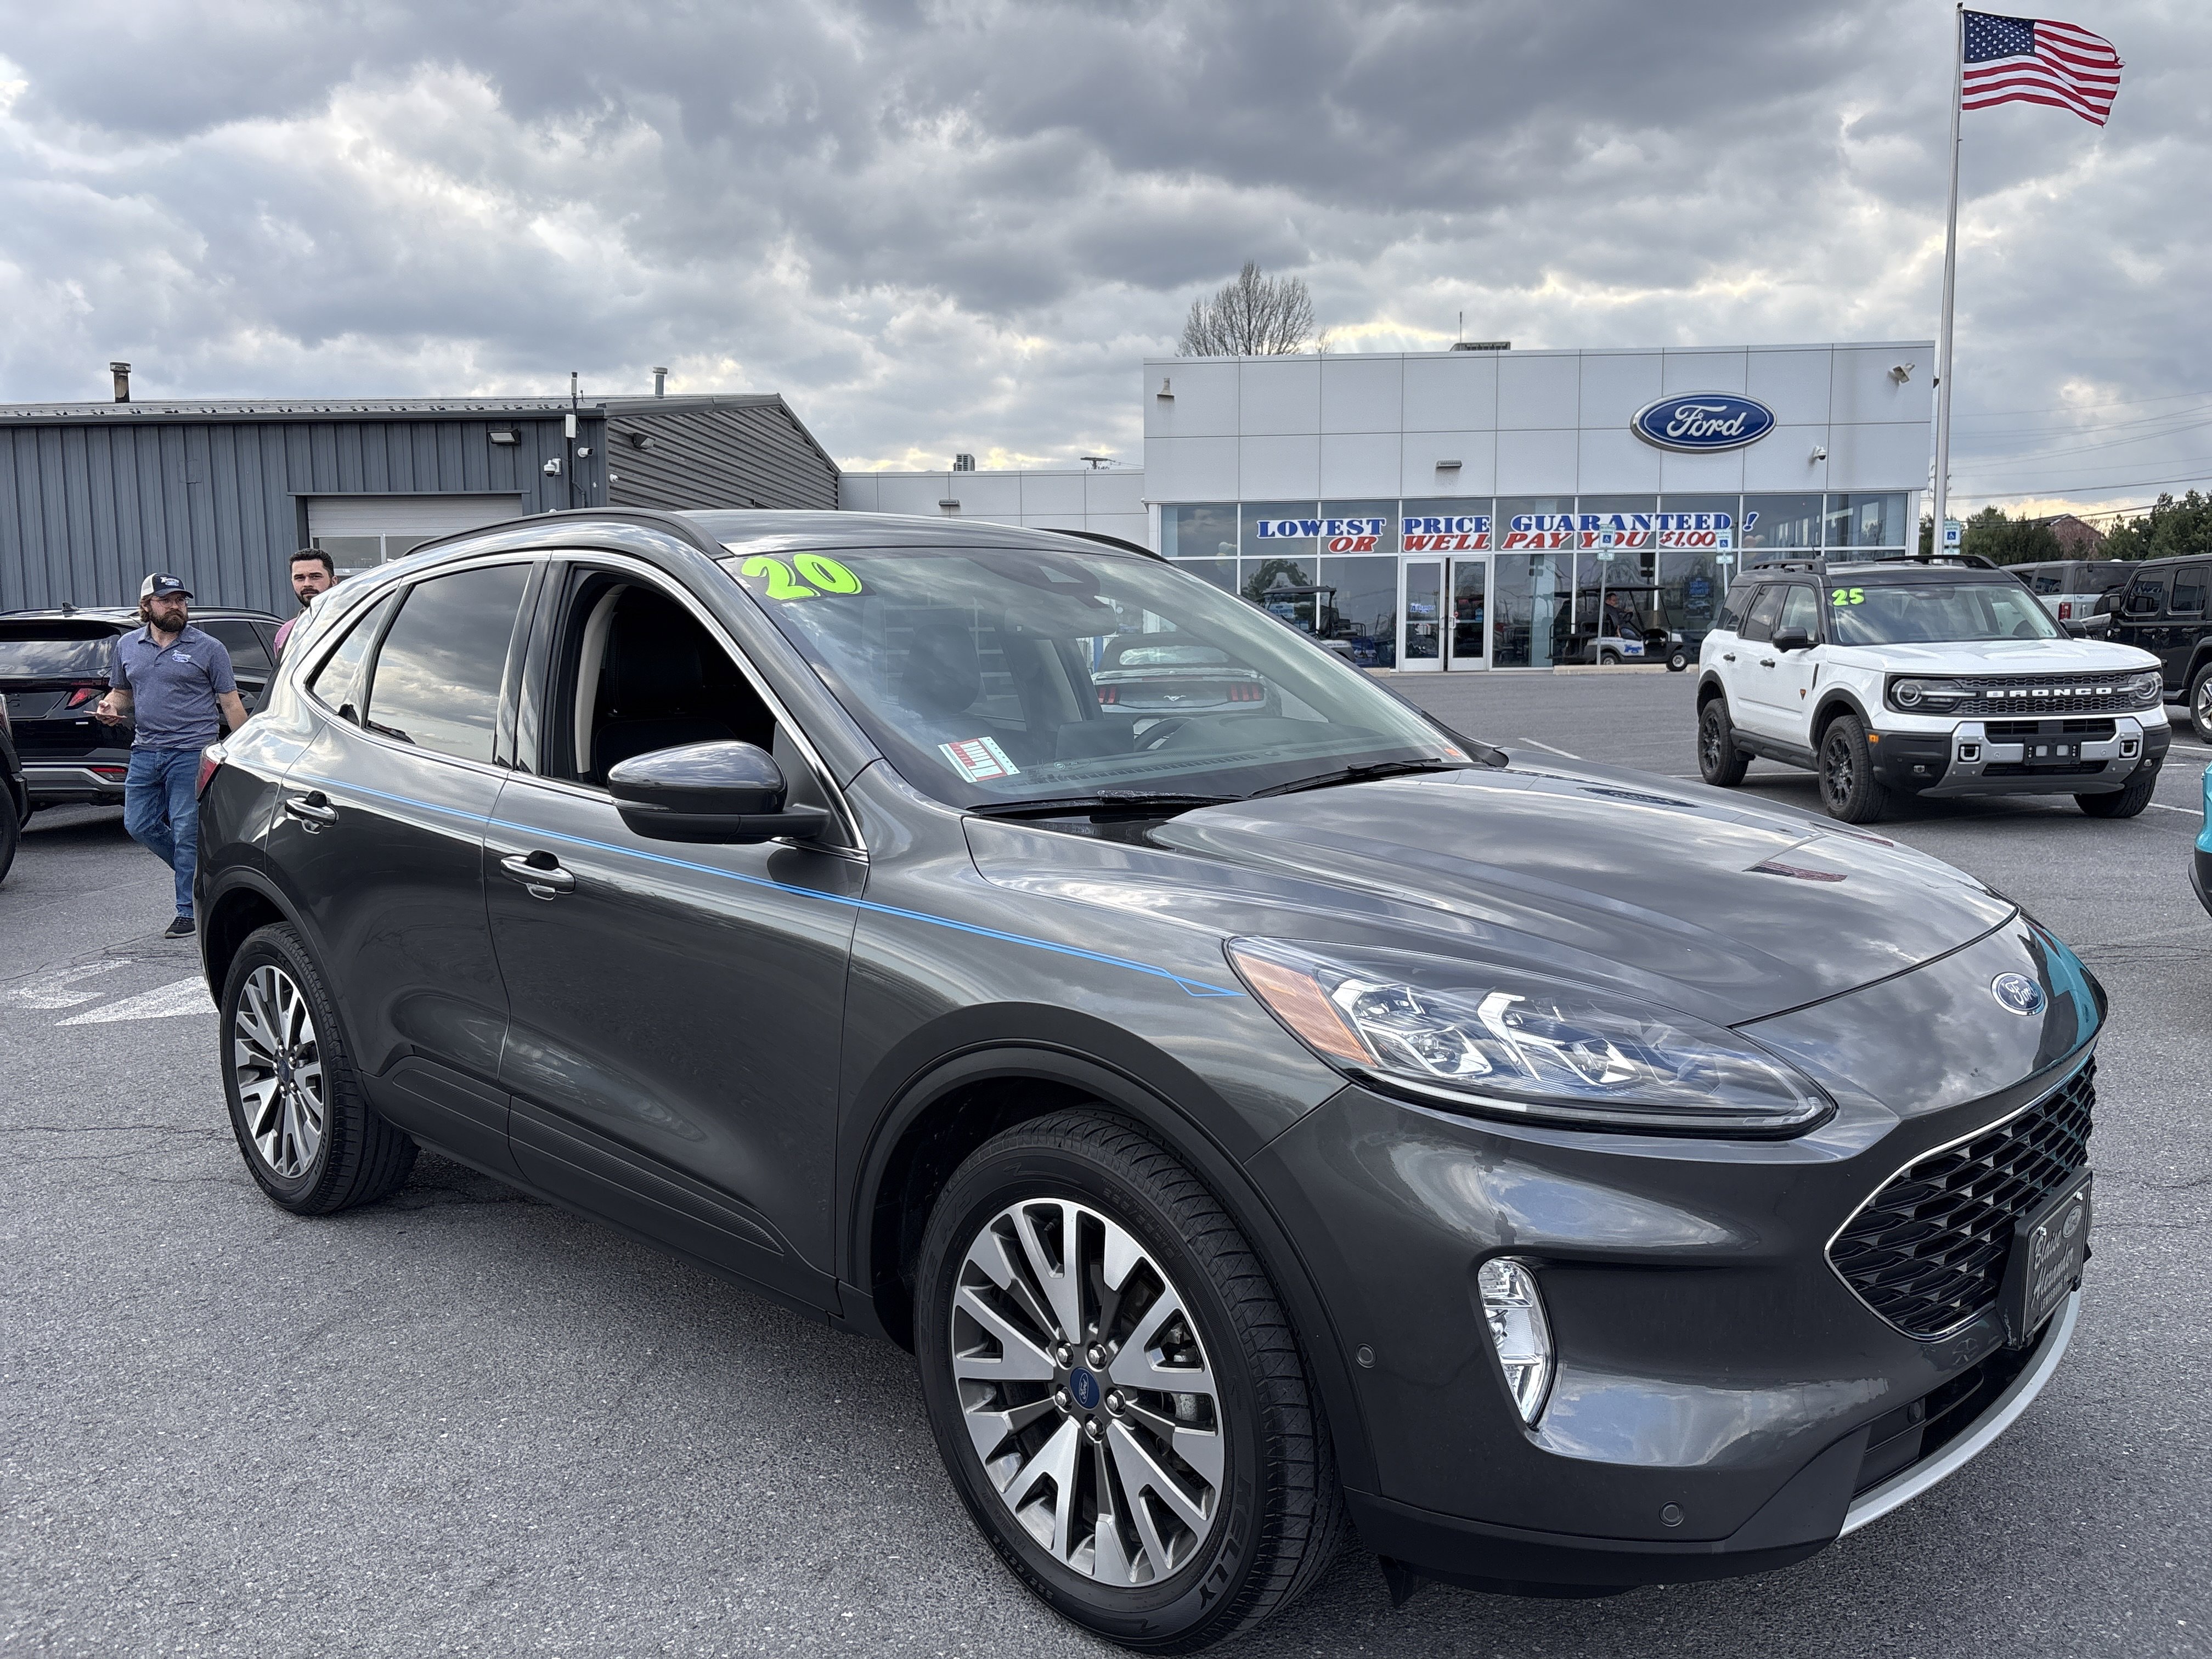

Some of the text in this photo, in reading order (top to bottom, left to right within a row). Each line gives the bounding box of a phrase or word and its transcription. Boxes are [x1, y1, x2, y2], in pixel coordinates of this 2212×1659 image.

[1667, 405, 1747, 437] Ford
[1258, 518, 1385, 537] LOWEST
[1403, 517, 1490, 534] PRICE
[1511, 514, 1731, 531] GUARANTEED
[1328, 536, 1378, 552] OR
[1403, 534, 1490, 551] WE'LL
[1503, 532, 1572, 549] PAY
[1659, 531, 1716, 547] $1,00
[741, 554, 862, 600] 20
[1831, 588, 1864, 606] 25
[1986, 687, 2112, 698] BRONCO
[2005, 979, 2038, 1006] Ford
[1199, 1474, 1251, 1611] KELLY
